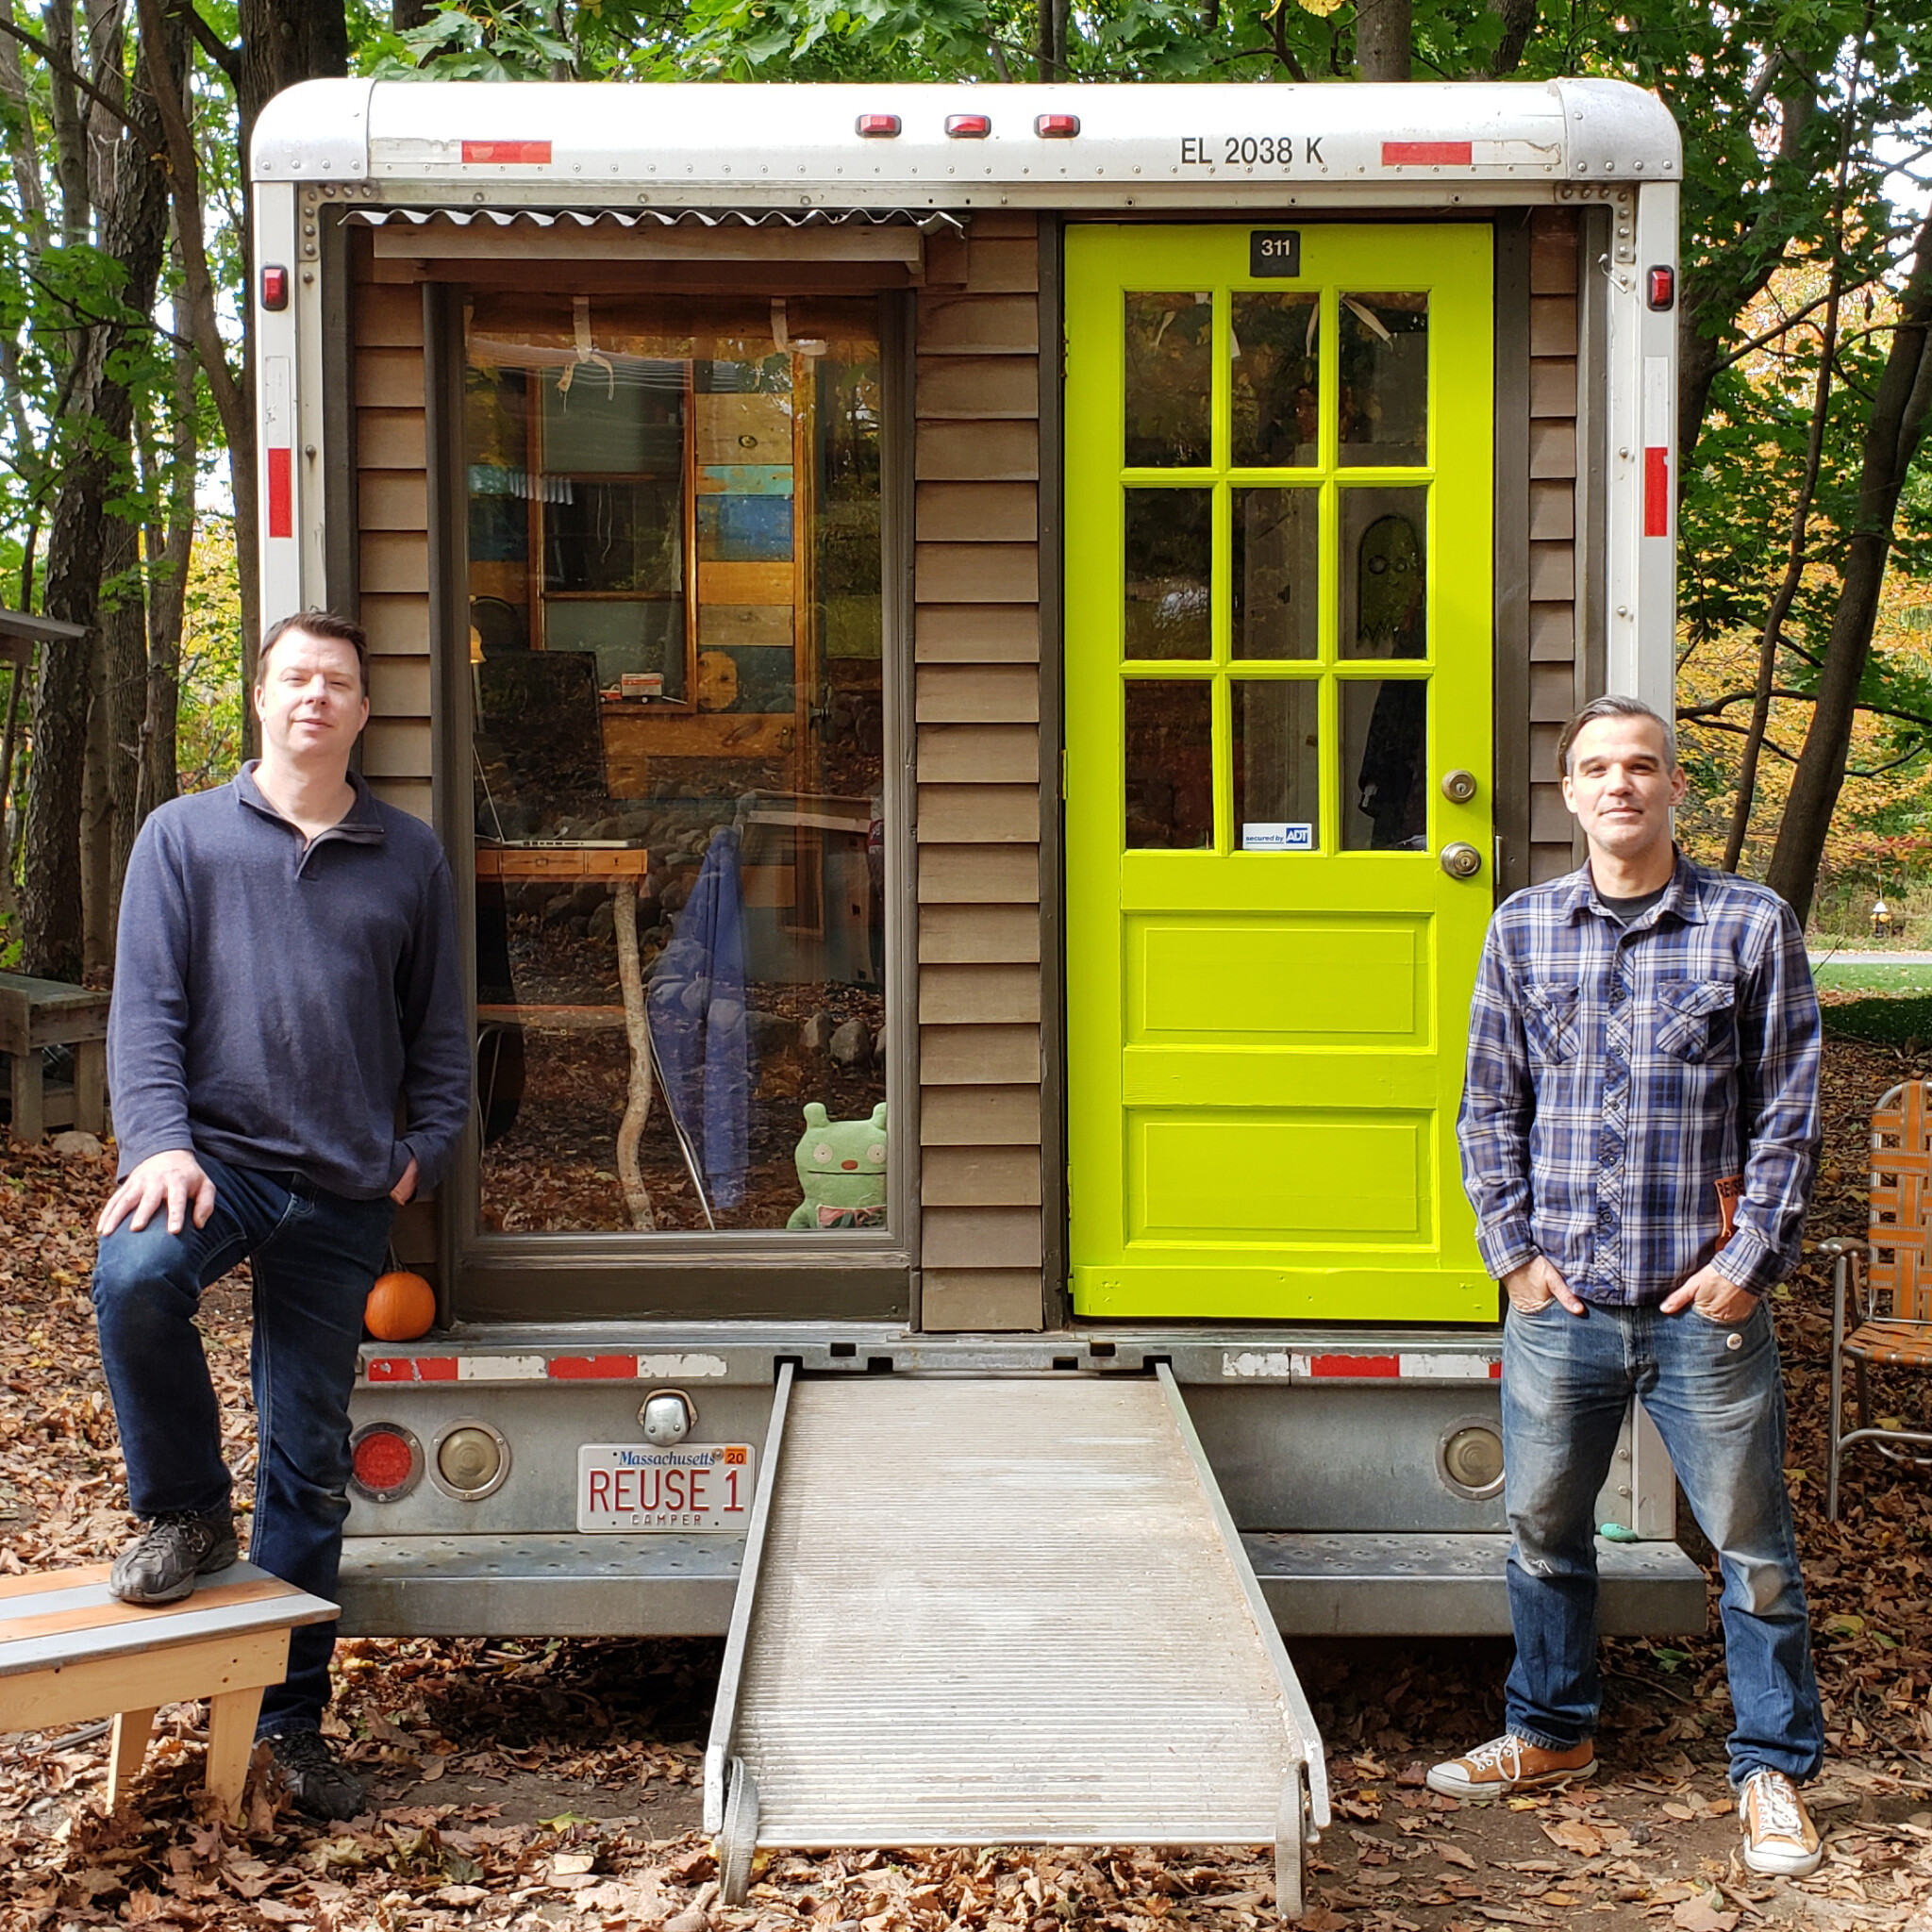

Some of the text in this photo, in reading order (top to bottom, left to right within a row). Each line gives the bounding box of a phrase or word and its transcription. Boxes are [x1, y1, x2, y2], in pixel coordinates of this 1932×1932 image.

[1181, 137, 1324, 164] EL 2038 K
[1261, 239, 1291, 257] 311
[1287, 830, 1307, 842] ADT
[619, 1451, 744, 1466] Massachusetts 20
[590, 1469, 743, 1512] REUSE 1
[631, 1514, 701, 1525] CAMPER
